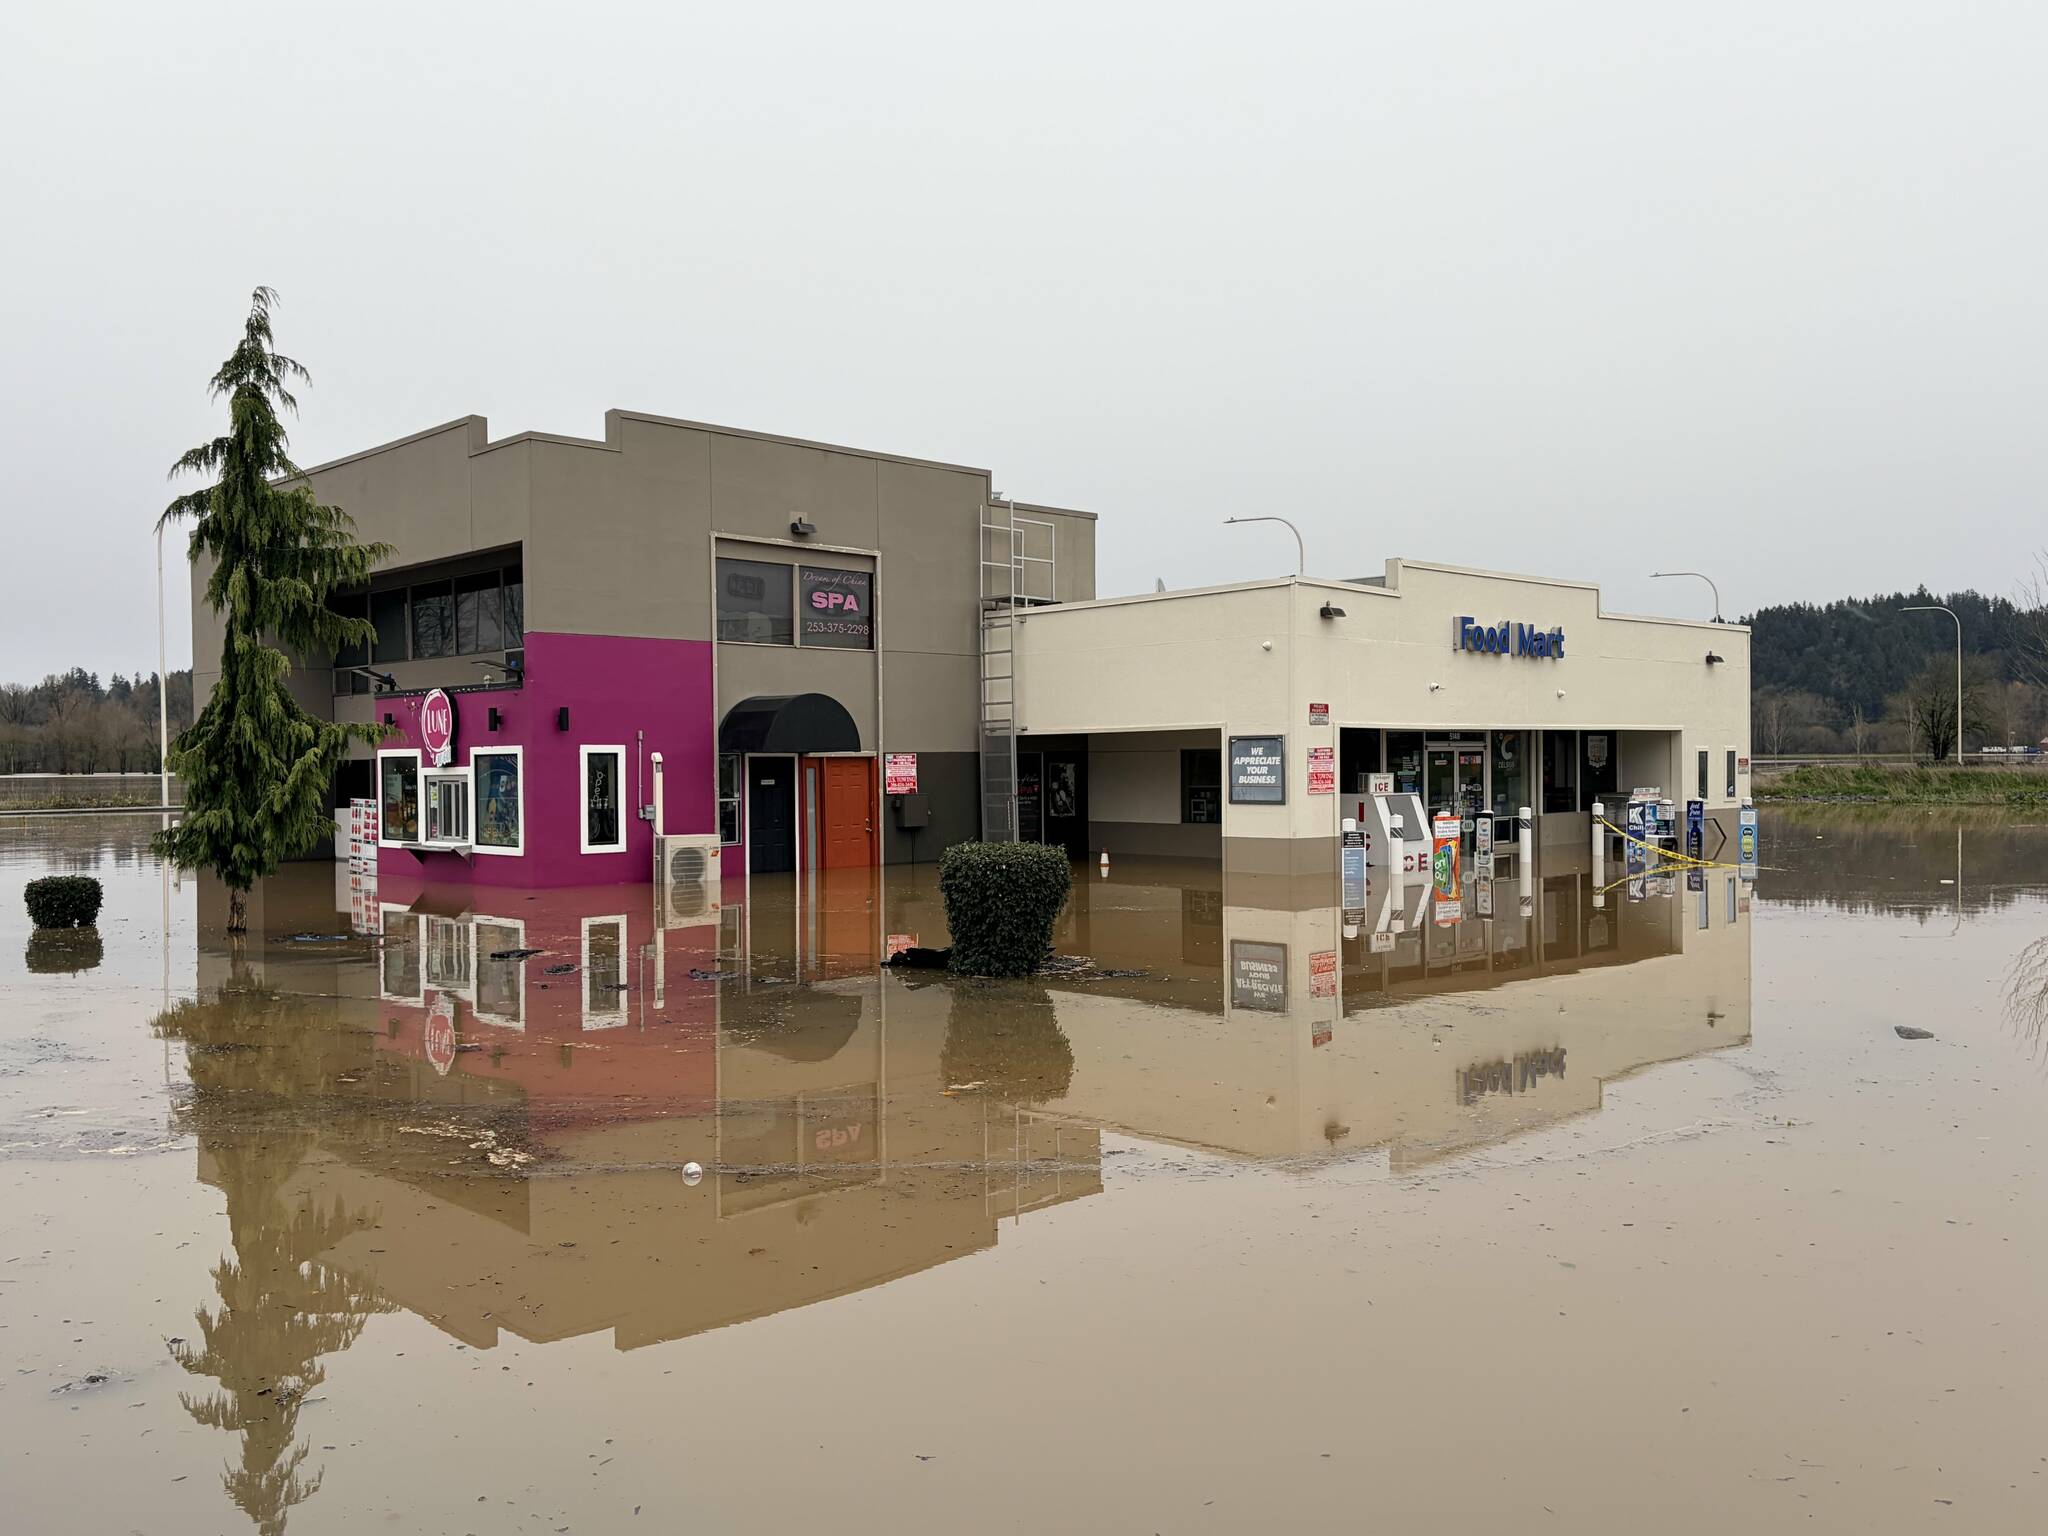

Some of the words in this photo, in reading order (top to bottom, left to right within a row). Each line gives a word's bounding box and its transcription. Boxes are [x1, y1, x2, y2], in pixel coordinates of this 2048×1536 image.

[802, 571, 830, 583] Dream
[825, 573, 842, 590] of
[811, 591, 859, 611] SPA
[807, 622, 870, 635] 253-375-2298
[1453, 616, 1510, 654] Food
[1511, 622, 1565, 659] Mart
[427, 708, 448, 736] LUNE
[1251, 747, 1263, 756] WE
[1233, 756, 1281, 765] APPRECIATE
[1246, 766, 1269, 774] YOUR
[1238, 775, 1276, 784] BUSINESS
[1374, 782, 1389, 792] ICE
